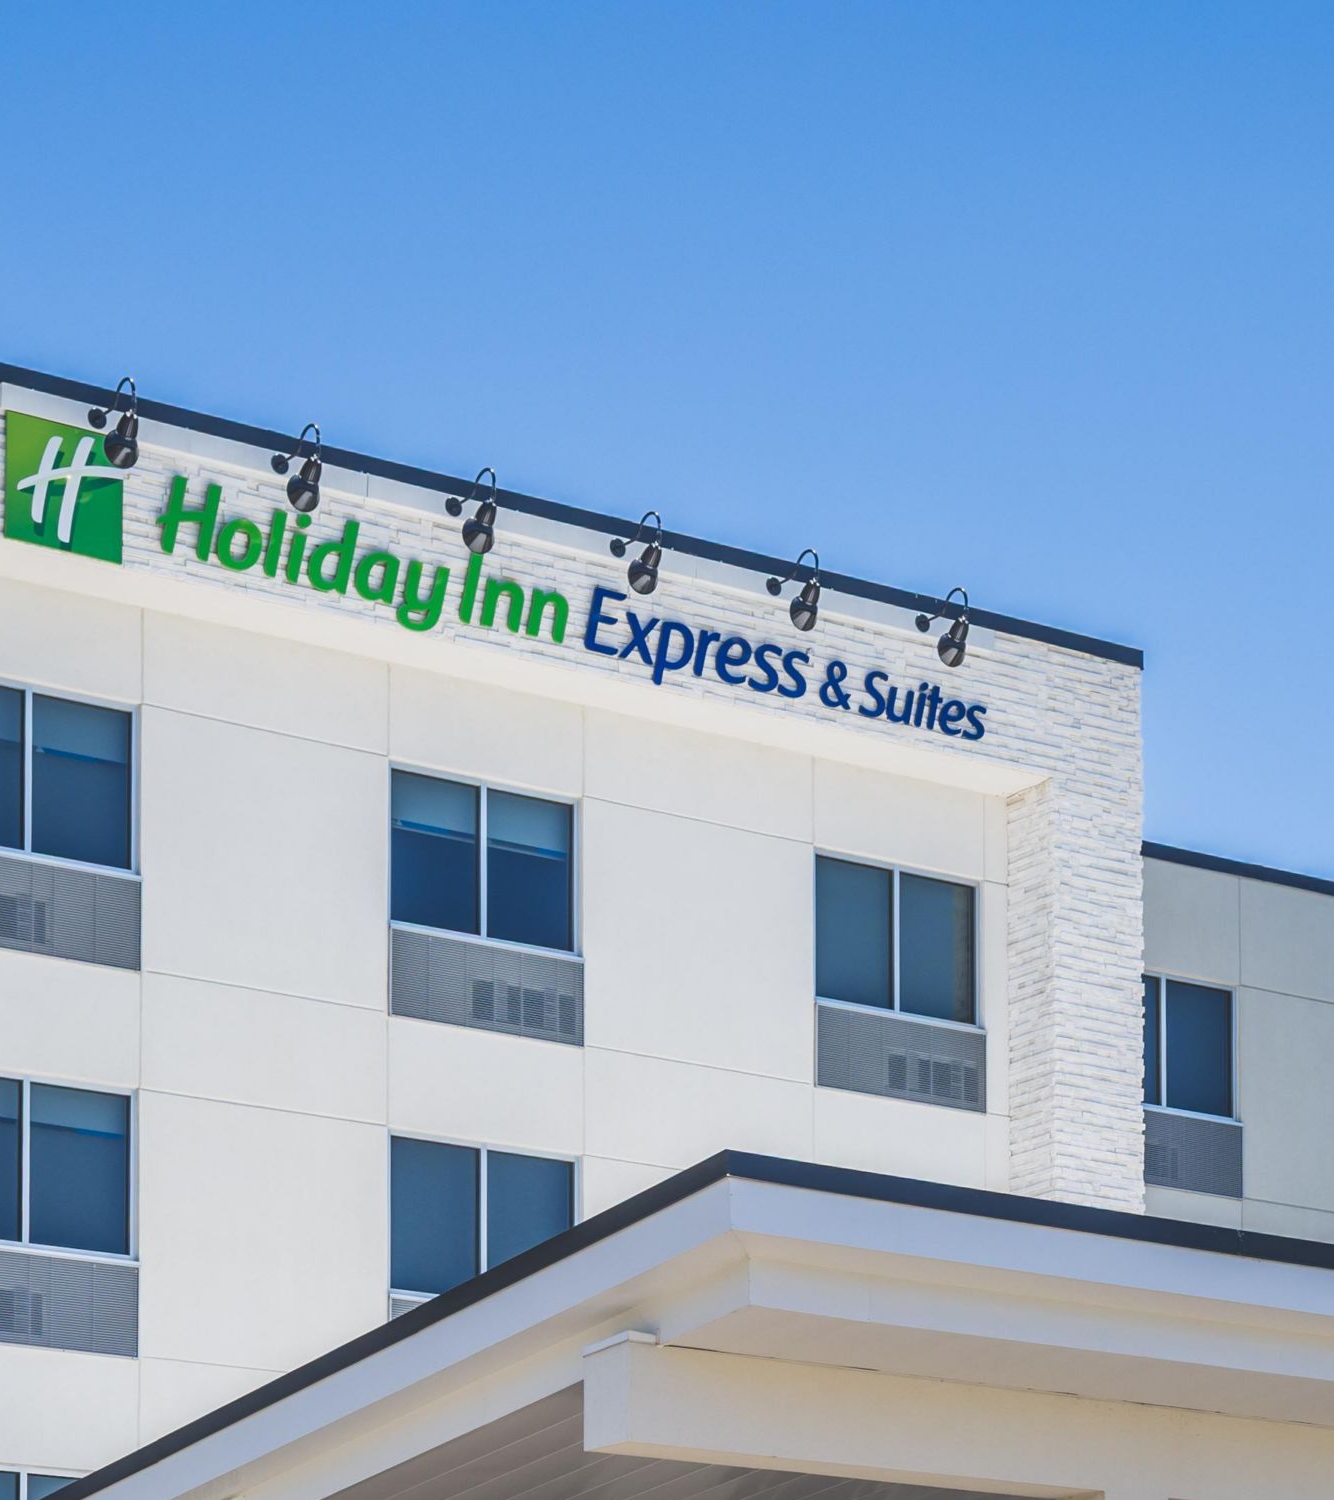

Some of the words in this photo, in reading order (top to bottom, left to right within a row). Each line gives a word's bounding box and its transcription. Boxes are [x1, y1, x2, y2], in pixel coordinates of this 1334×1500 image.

[155, 474, 451, 632] Holiday
[458, 552, 569, 644] Inn
[584, 584, 810, 698] Express
[819, 660, 851, 710] &
[858, 670, 987, 740] Suites
